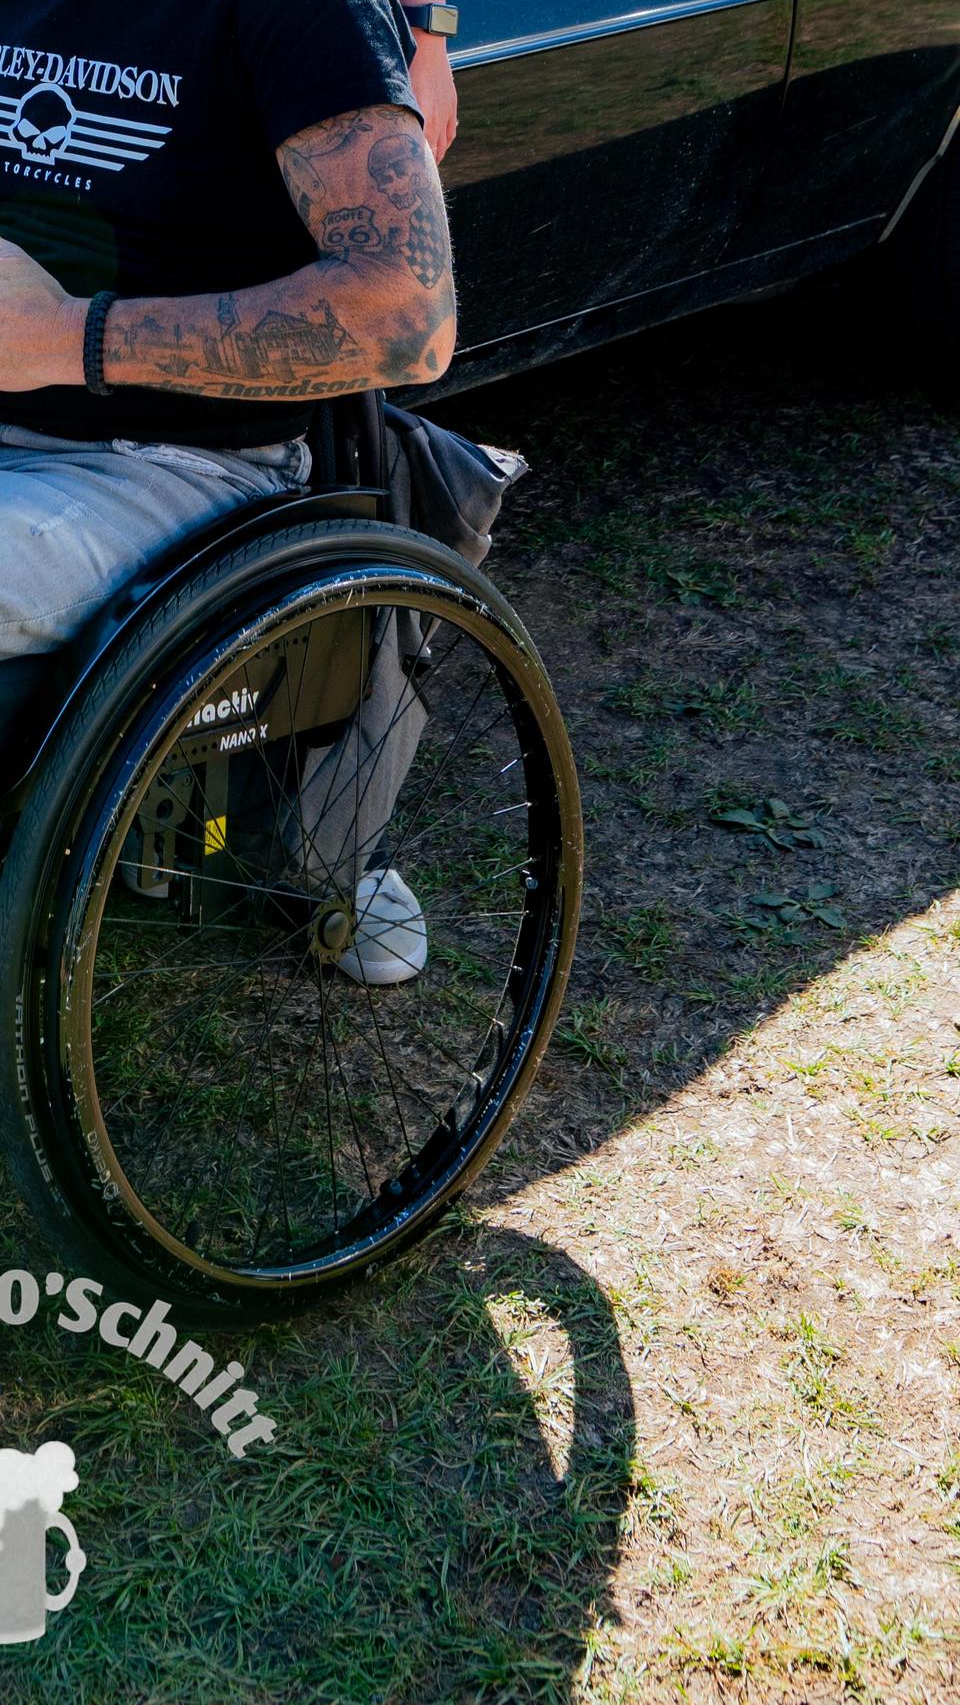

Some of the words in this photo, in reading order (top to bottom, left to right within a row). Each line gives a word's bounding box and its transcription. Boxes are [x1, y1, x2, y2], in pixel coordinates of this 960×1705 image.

[328, 209, 366, 225] ROUTE
[327, 226, 370, 244] 66
[220, 728, 256, 752] NANO
[25, 1114, 54, 1184] PLUS
